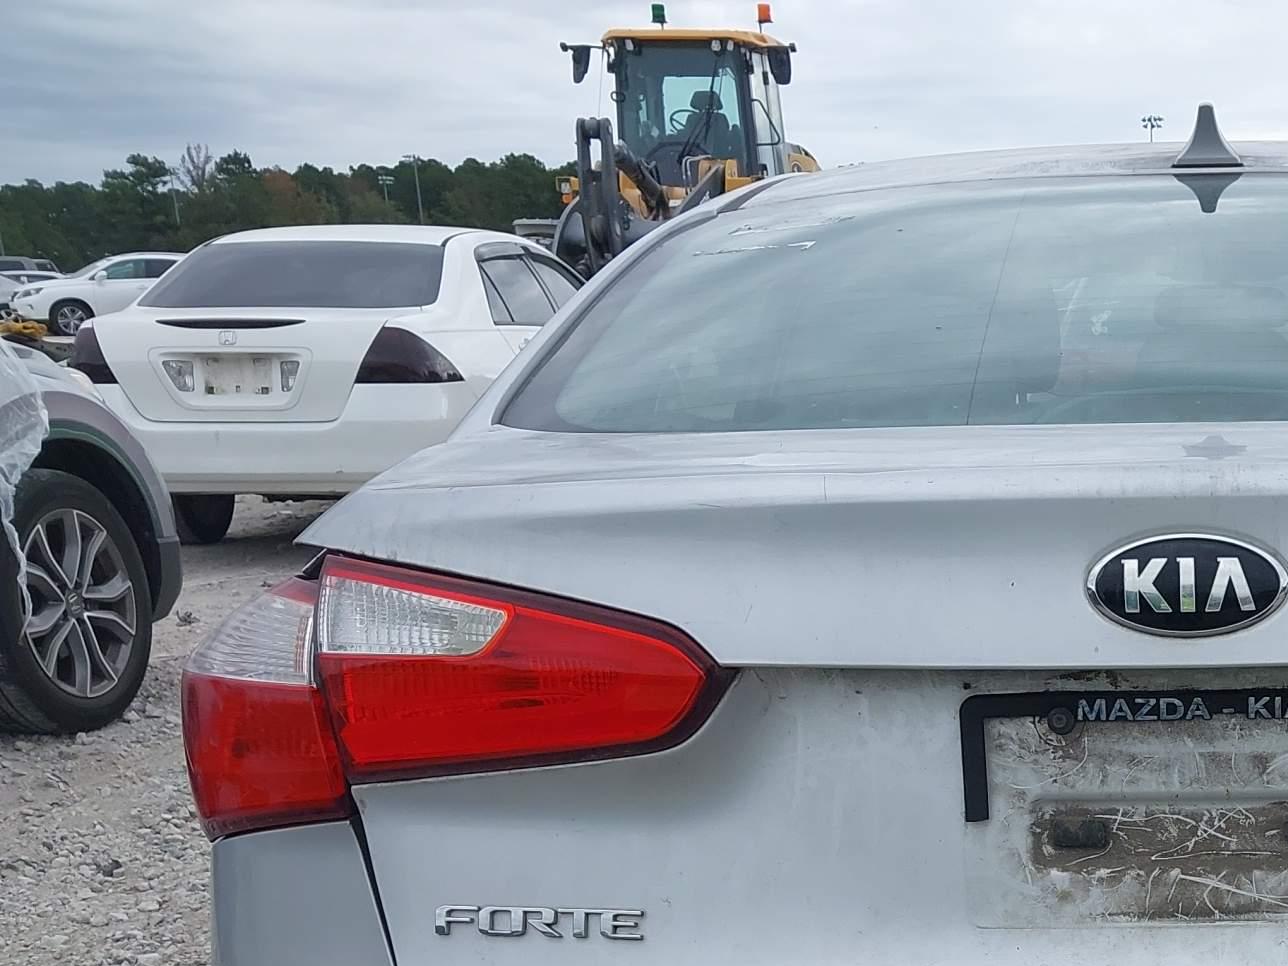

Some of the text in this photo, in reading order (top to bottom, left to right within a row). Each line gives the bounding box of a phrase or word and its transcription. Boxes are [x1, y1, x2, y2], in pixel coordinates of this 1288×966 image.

[1120, 556, 1257, 614] KIA
[1077, 696, 1211, 722] MAZDA
[435, 904, 645, 941] FORTE
